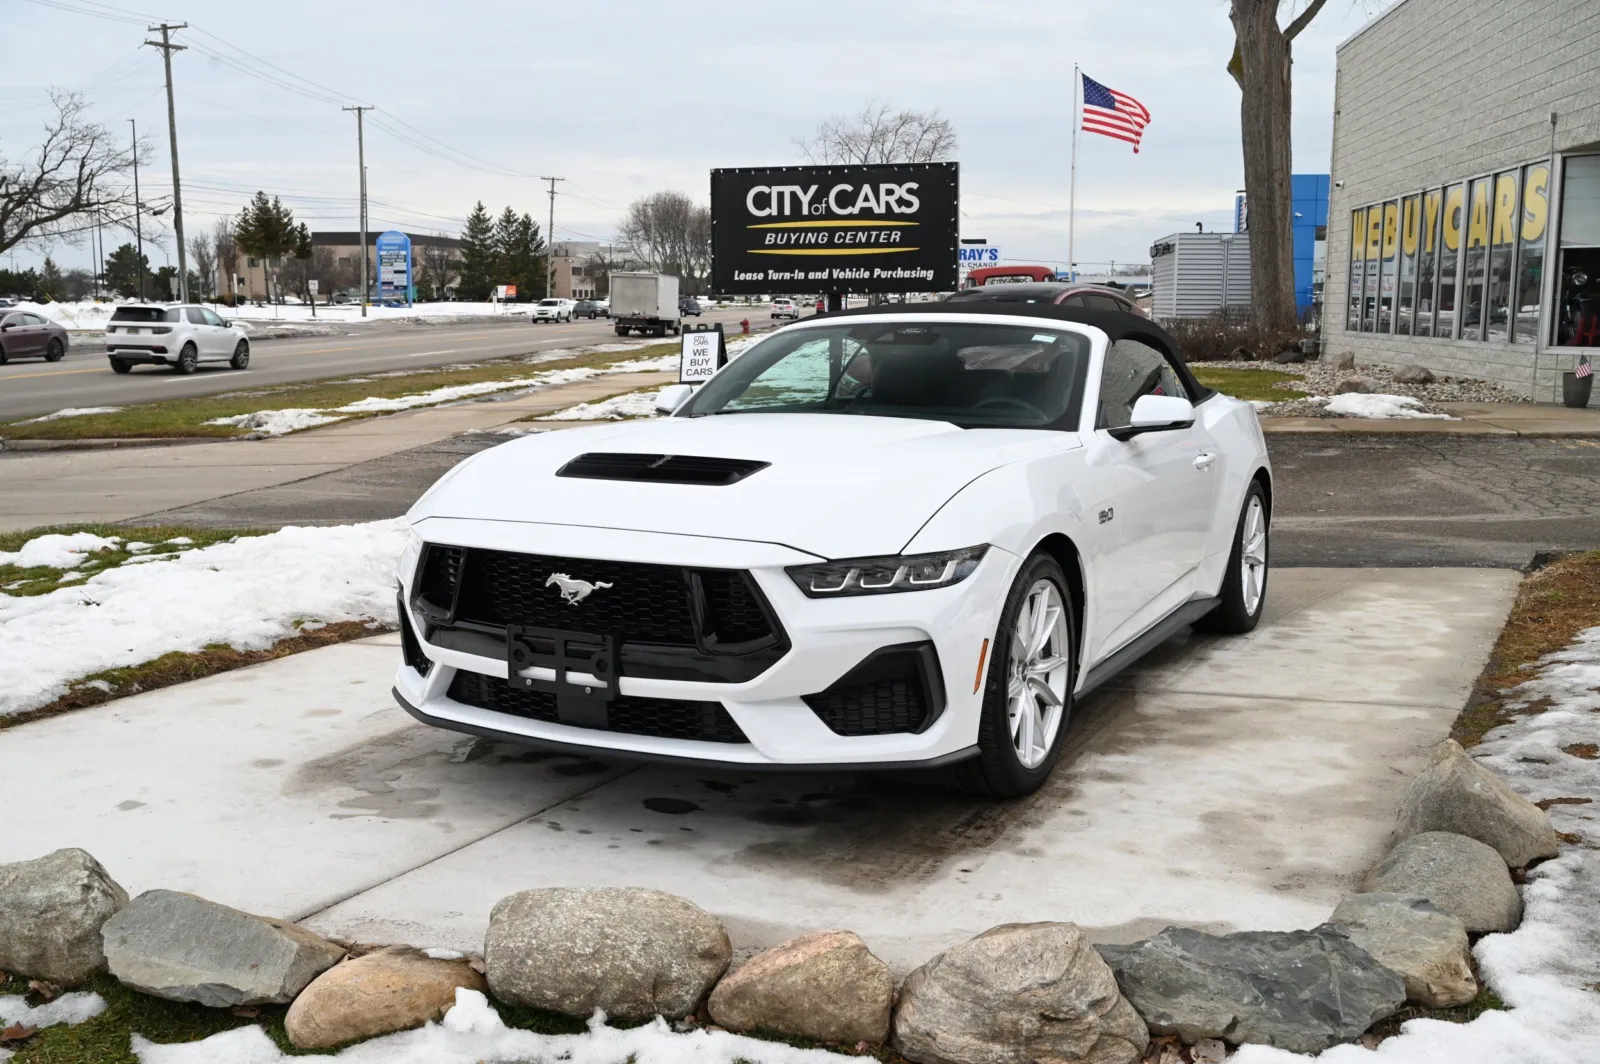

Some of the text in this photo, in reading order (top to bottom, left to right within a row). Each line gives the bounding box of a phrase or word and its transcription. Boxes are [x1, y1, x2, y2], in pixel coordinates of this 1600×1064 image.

[746, 182, 920, 217] CITY of CARS
[1443, 167, 1549, 250] CARS
[764, 231, 901, 245] BUYING CENTER
[734, 267, 934, 281] Lease Turn-In and Vehicle Purchasing
[693, 348, 708, 356] WE
[690, 358, 710, 367] BUY
[686, 367, 713, 377] CARS
